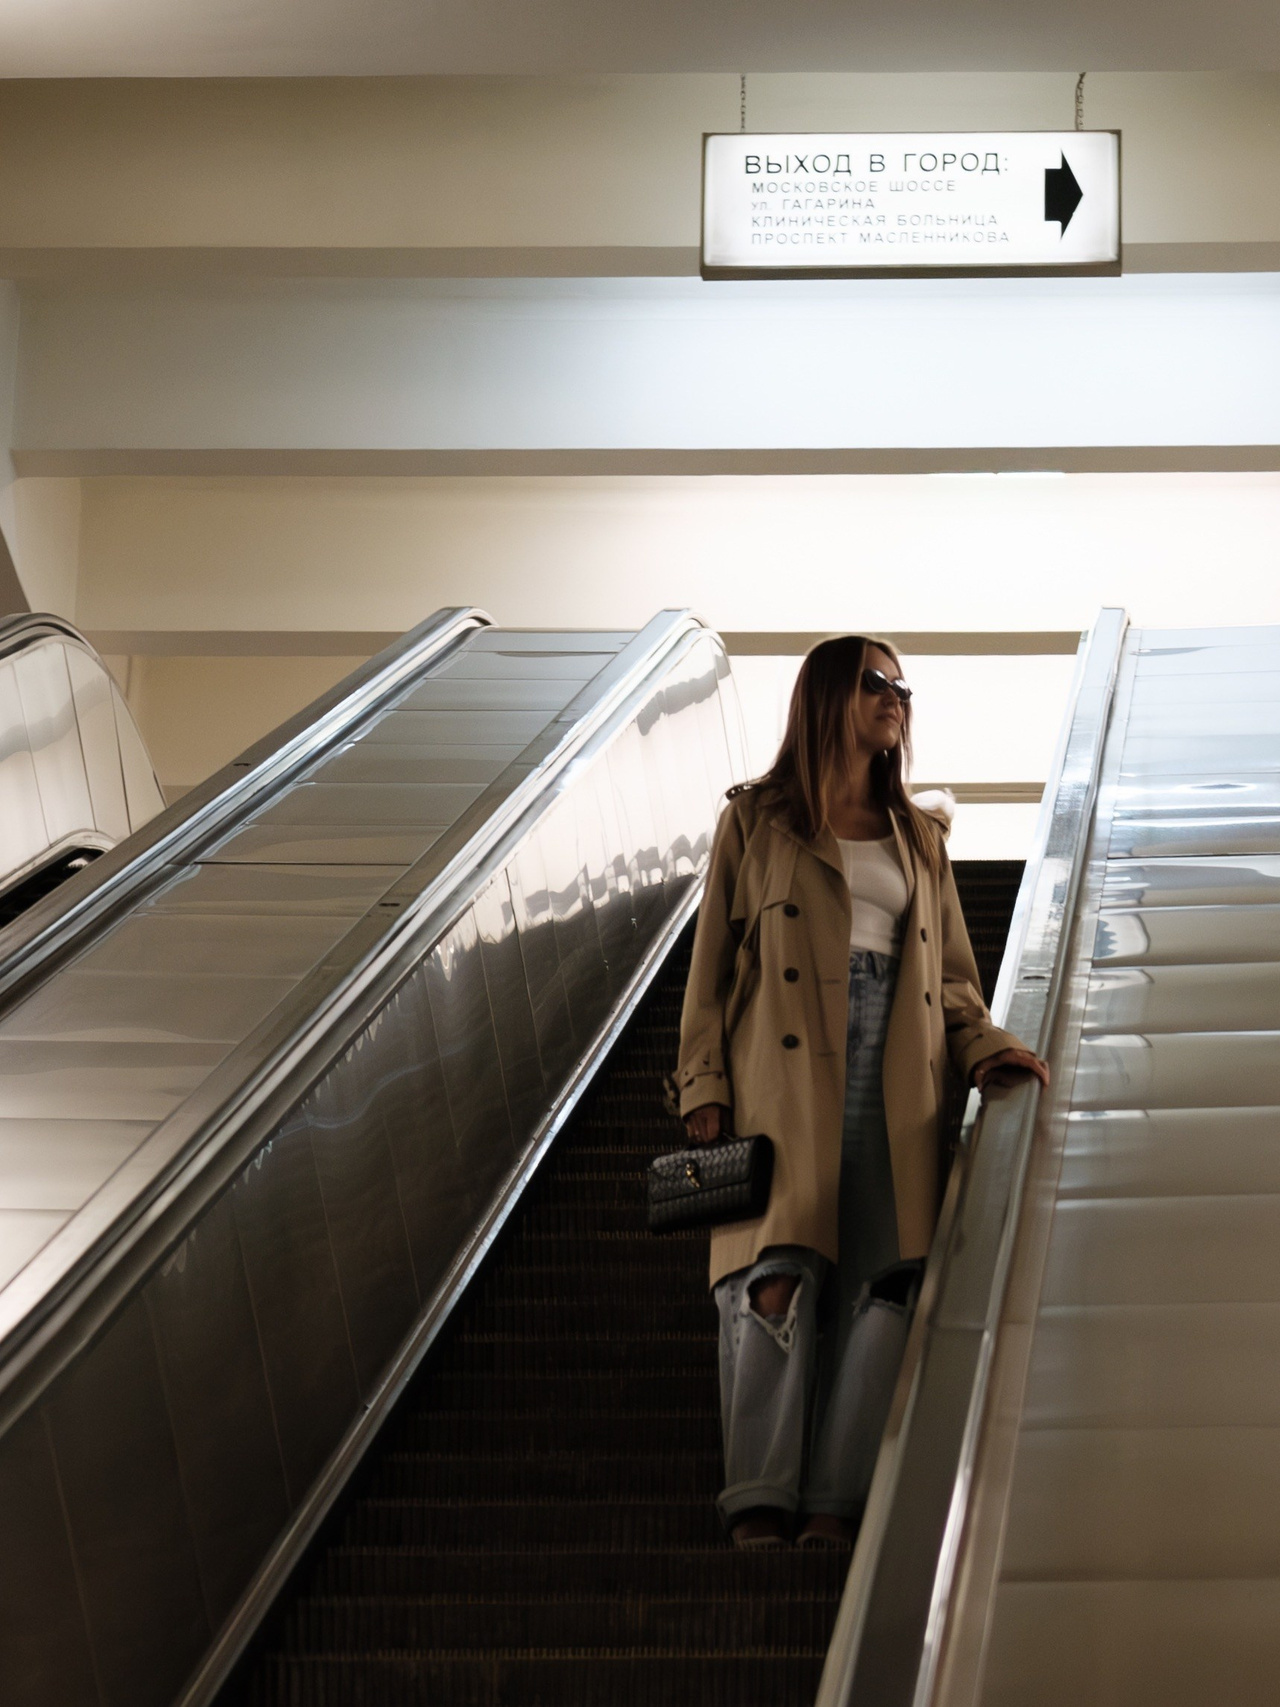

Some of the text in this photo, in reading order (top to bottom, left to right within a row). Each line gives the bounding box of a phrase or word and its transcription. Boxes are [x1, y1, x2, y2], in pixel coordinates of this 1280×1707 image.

[744, 152, 1009, 177] ВЫХОД В ГОРОД:
[751, 179, 956, 194] МОСКОВСКОЕ ШОССЕ
[782, 197, 876, 210] ГАГАРИНА
[751, 213, 998, 228] КЛИНИЧЕСКАЯ БОЛЬНИЦА
[751, 231, 1010, 245] ПРОСПЕКТ МАСЛЕННИКОВА
